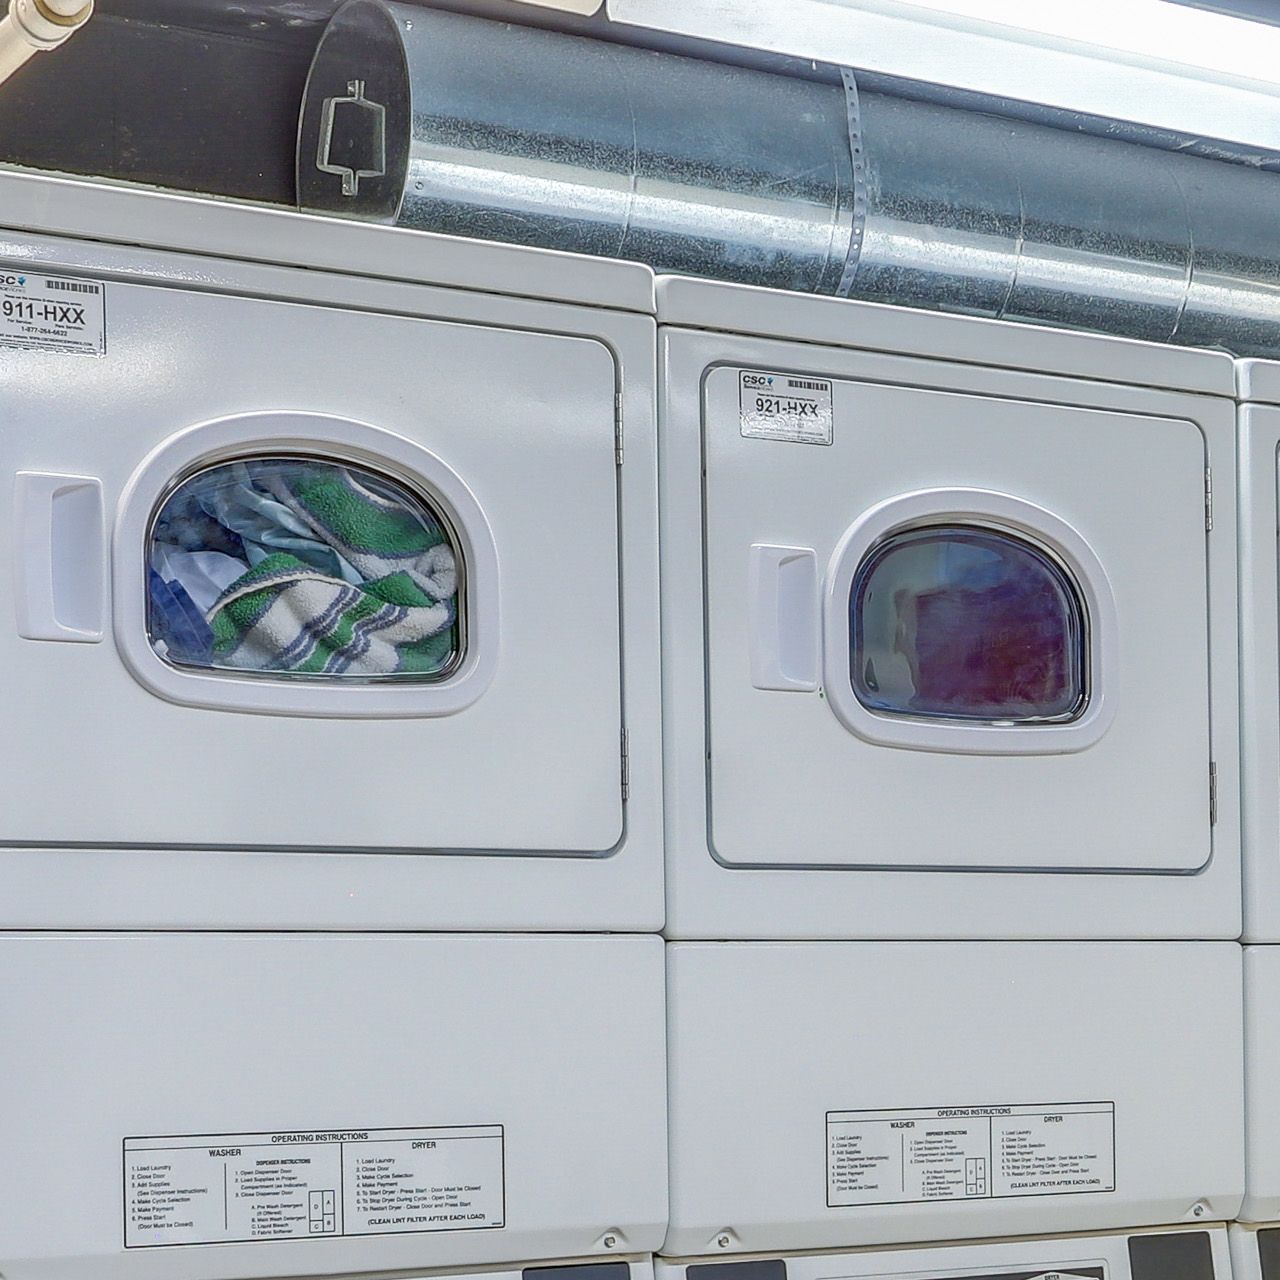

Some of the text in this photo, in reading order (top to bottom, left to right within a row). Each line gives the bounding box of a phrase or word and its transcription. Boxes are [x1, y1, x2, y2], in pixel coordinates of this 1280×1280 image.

[3, 300, 85, 325] 911-HXX
[743, 375, 766, 384] CSC
[209, 1149, 241, 1157] WASHER
